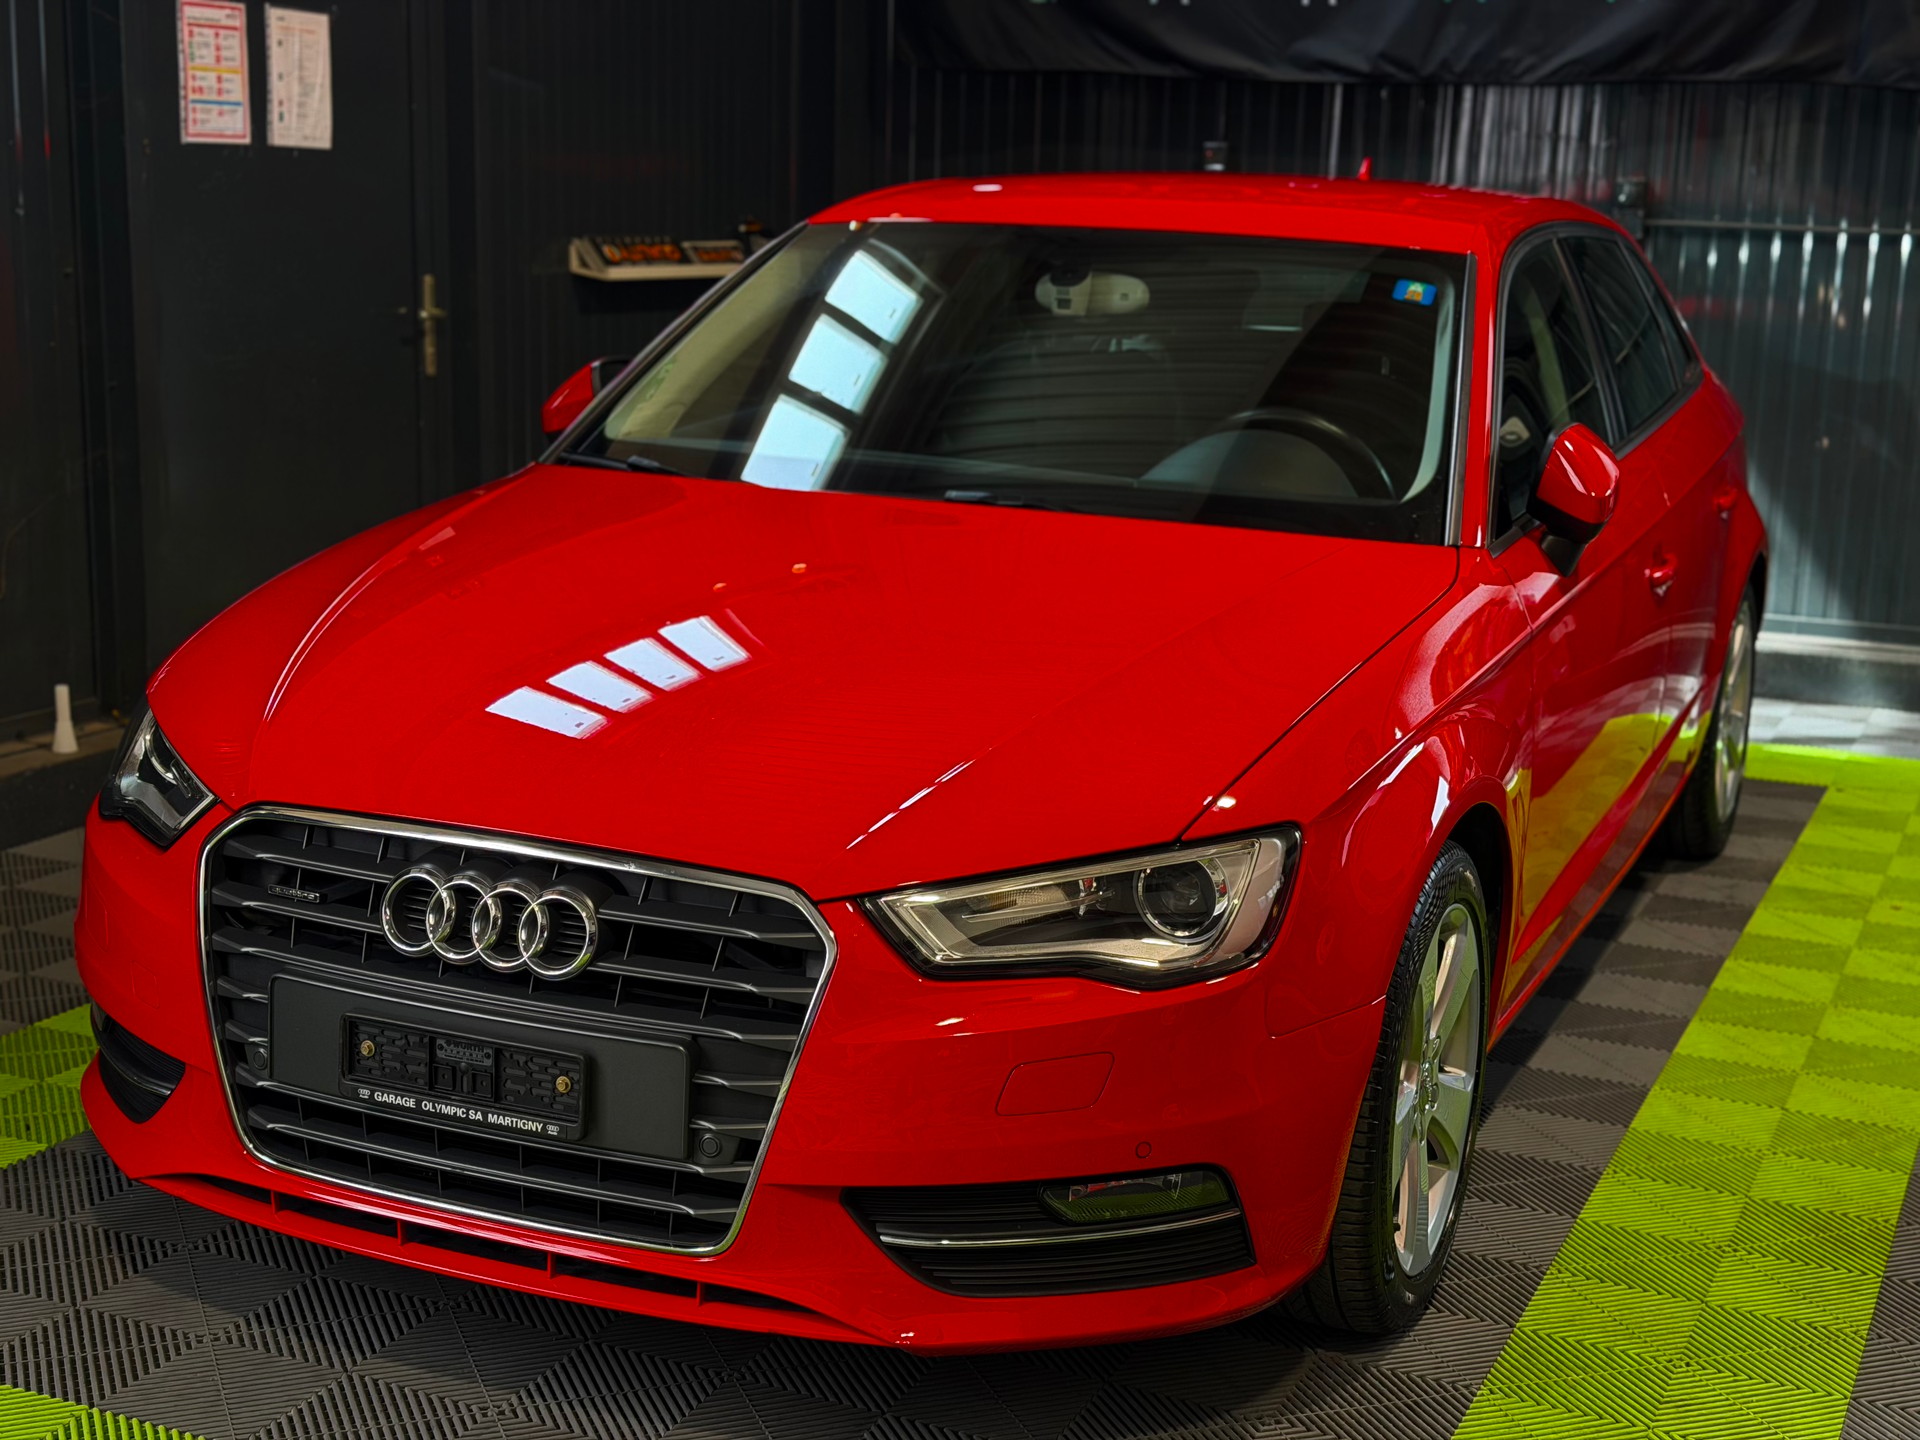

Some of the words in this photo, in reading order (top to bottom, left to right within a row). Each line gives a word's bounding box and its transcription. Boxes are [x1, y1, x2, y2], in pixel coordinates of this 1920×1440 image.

[374, 1091, 416, 1108] GARAGE
[421, 1101, 467, 1118] OLYMPIC
[468, 1111, 483, 1122] SA
[487, 1113, 543, 1132] MARTIGNY
